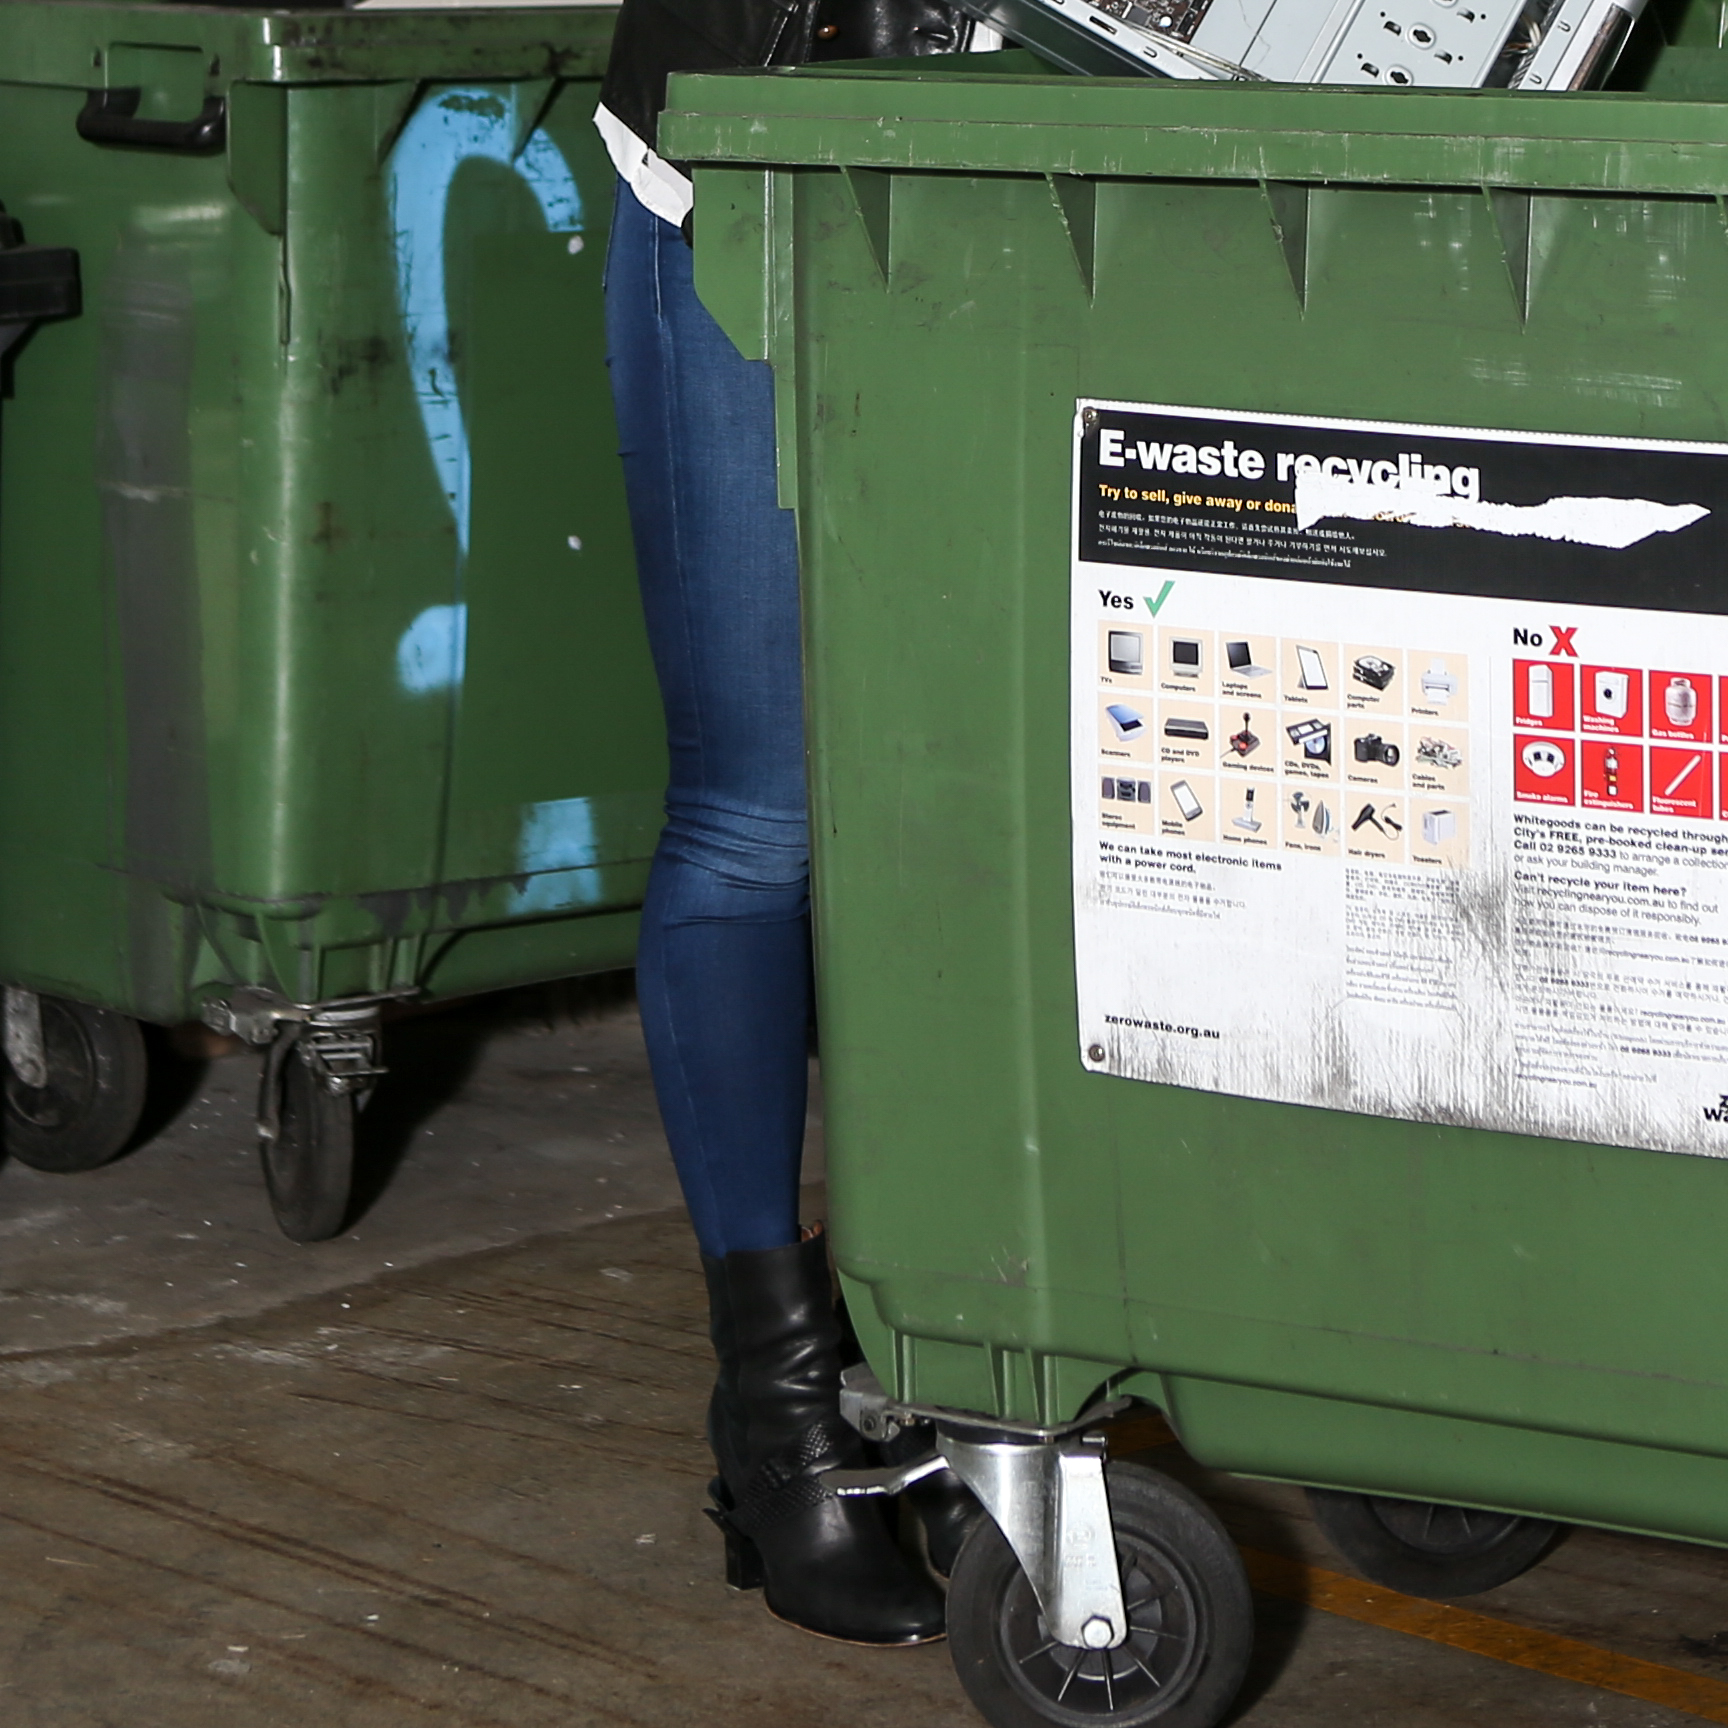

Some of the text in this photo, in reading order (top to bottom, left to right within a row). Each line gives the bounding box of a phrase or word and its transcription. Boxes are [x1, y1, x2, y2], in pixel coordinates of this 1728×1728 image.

[1098, 428, 1266, 480] E-waste
[1098, 483, 1121, 502] Try
[1124, 486, 1138, 501] to
[1141, 488, 1170, 505] sell,
[1173, 490, 1202, 508] give
[1205, 496, 1243, 512] away
[1246, 498, 1261, 512] or
[1098, 589, 1134, 610] Yes
[1513, 627, 1543, 647] No
[1100, 676, 1112, 684] TVs
[1160, 682, 1196, 693] Computers
[1221, 681, 1248, 690] Laptops
[1222, 689, 1262, 700] and screens
[1222, 761, 1275, 773] Gaming devices
[1513, 813, 1581, 830] Whitegoods
[1585, 822, 1606, 832] can
[1610, 822, 1624, 834] be
[1628, 826, 1678, 840] recycled
[1682, 829, 1728, 846] through
[1513, 827, 1546, 842] City's
[1549, 829, 1582, 844] FREE,
[1586, 835, 1652, 851] pre-booked
[1655, 842, 1707, 857] clean-up
[1513, 840, 1536, 852] Call
[1540, 842, 1554, 853] 02
[1557, 844, 1585, 856] 9265
[1588, 847, 1617, 859] 9333
[1620, 851, 1629, 861] to
[1632, 853, 1671, 866] arrange
[1673, 857, 1680, 866] a
[1099, 840, 1282, 871] We can take most electronic items
[1099, 853, 1196, 874] with a power cord.
[1513, 853, 1659, 877] or ask your building manager.
[1514, 871, 1687, 897] Can't recycle your item here?
[1513, 883, 1719, 914] Visit recyclingnearyou.com.au to find out
[1513, 897, 1701, 927] how you can dispose of it responsibly.
[1104, 1015, 1221, 1039] zerowaste.org.au
